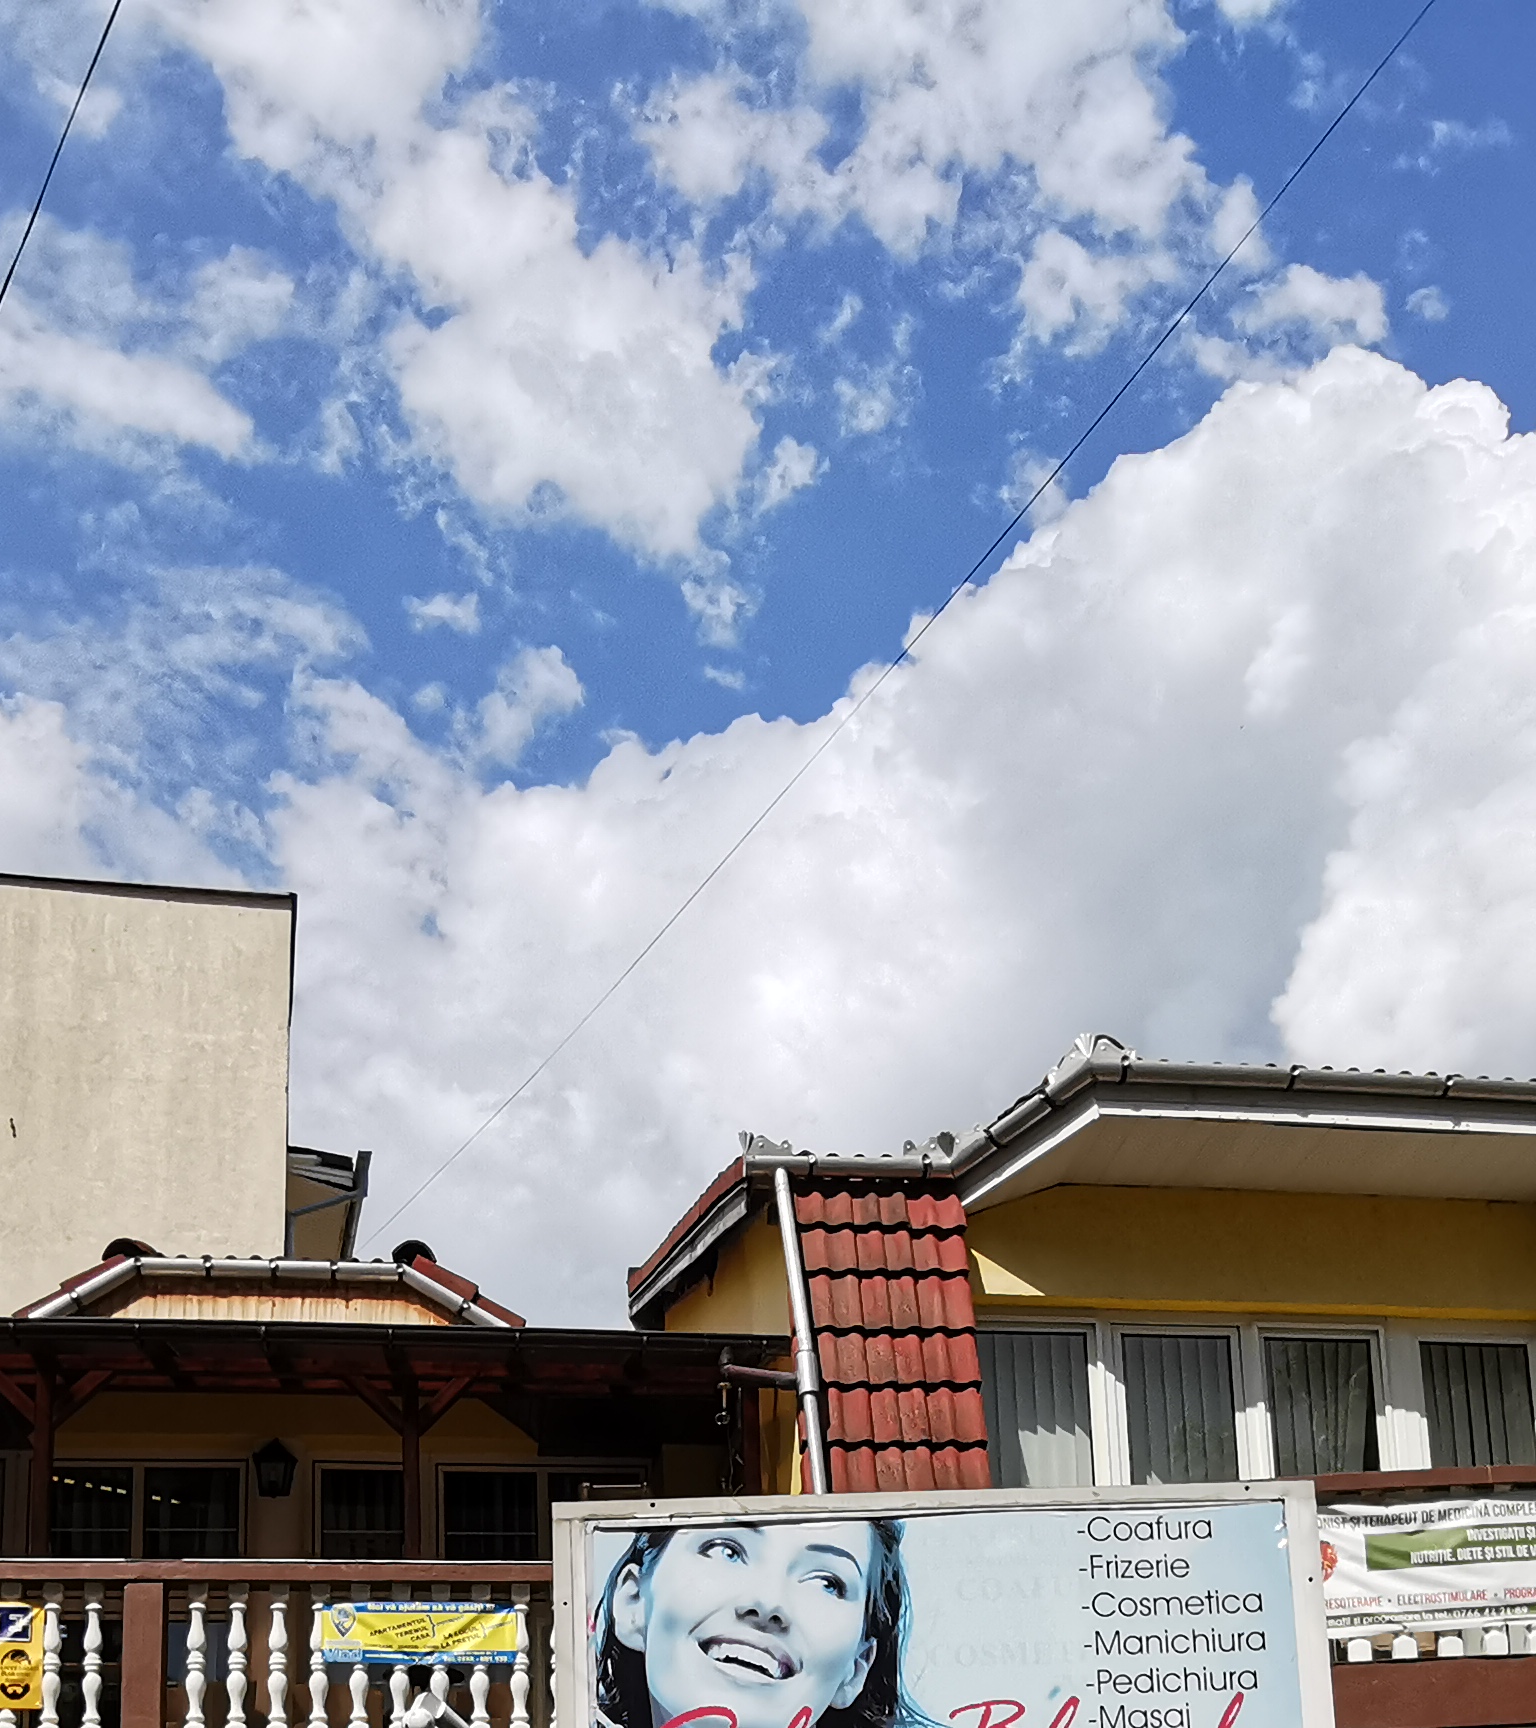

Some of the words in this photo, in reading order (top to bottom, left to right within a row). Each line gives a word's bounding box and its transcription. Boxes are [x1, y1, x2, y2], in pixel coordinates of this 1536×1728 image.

[1077, 1515, 1213, 1542] -Coafura
[1421, 1511, 1435, 1523] DE
[1496, 1545, 1515, 1559] STIL
[1516, 1544, 1528, 1557] DE
[1079, 1554, 1191, 1580] -Frizerie
[1081, 1590, 1264, 1618] -Cosmetica
[1397, 1589, 1488, 1606] ELECTROSTIMULARE
[1084, 1628, 1267, 1656] -Manichiura
[1086, 1666, 1259, 1694] -Pedichiura
